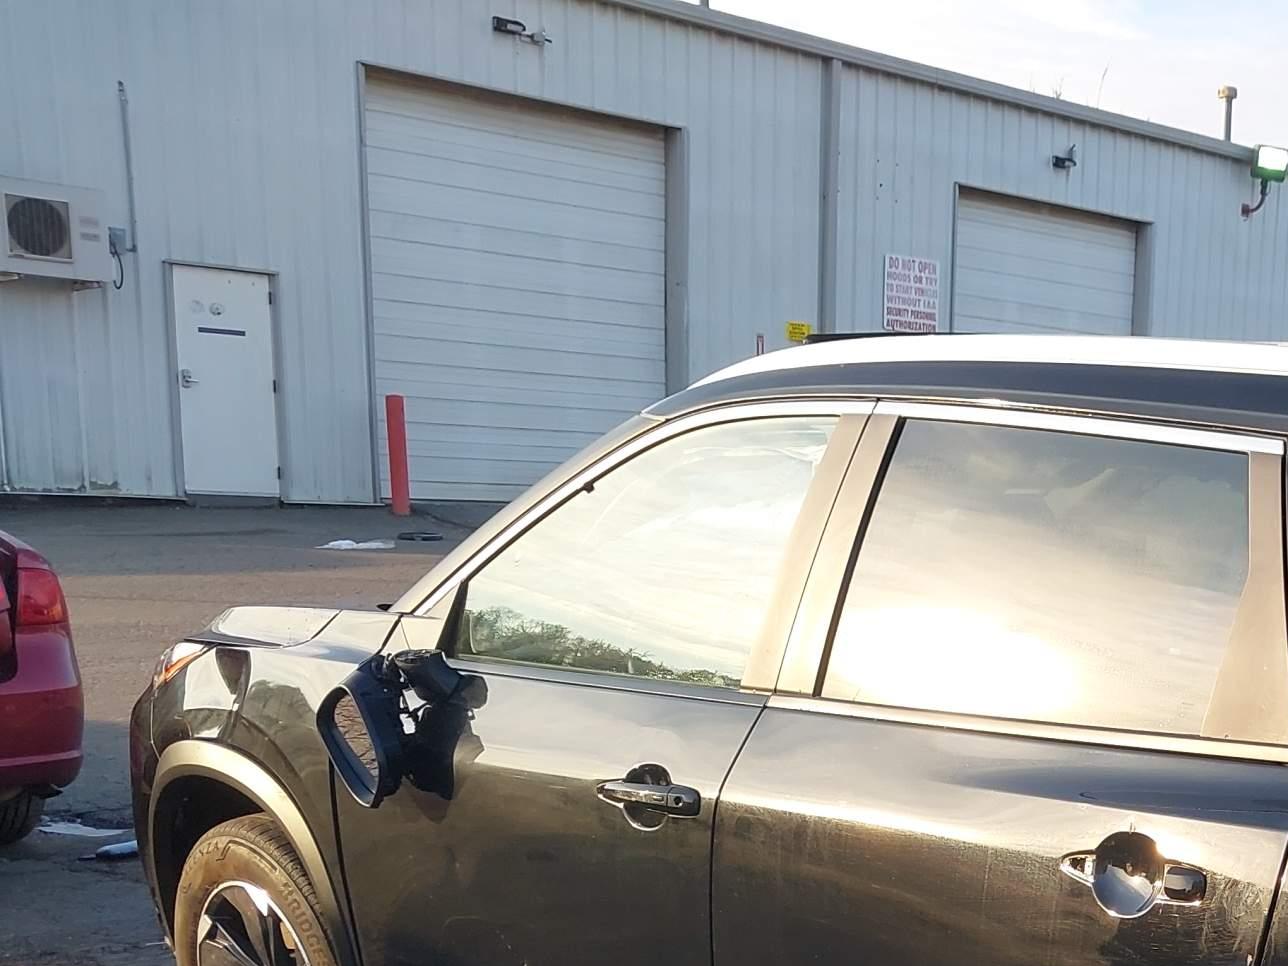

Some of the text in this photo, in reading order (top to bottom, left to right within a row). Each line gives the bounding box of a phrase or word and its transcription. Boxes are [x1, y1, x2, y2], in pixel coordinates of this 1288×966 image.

[889, 256, 936, 276] DO NOT OPEN
[913, 274, 923, 285] OR
[886, 295, 921, 308] WITHOUT
[886, 306, 909, 320] SECURITY
[886, 318, 936, 333] AUTHORIZATION
